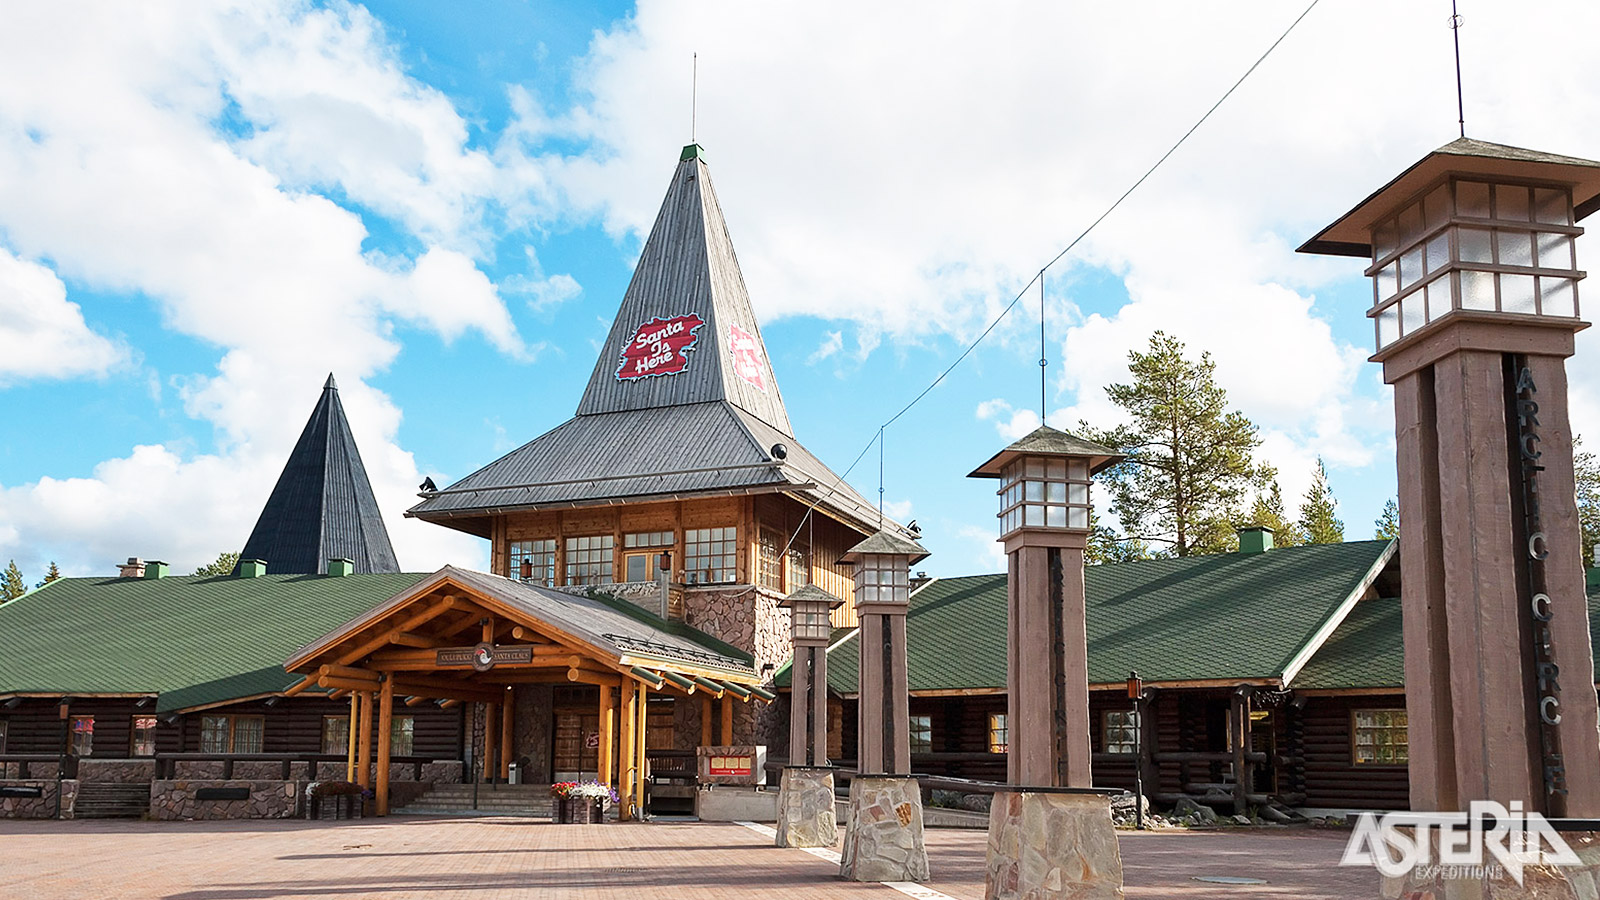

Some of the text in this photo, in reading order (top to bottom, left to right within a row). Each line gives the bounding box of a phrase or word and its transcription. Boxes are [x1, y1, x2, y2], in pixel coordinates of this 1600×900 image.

[636, 321, 684, 349] Santa
[650, 340, 671, 357] Is
[635, 351, 674, 374] Here
